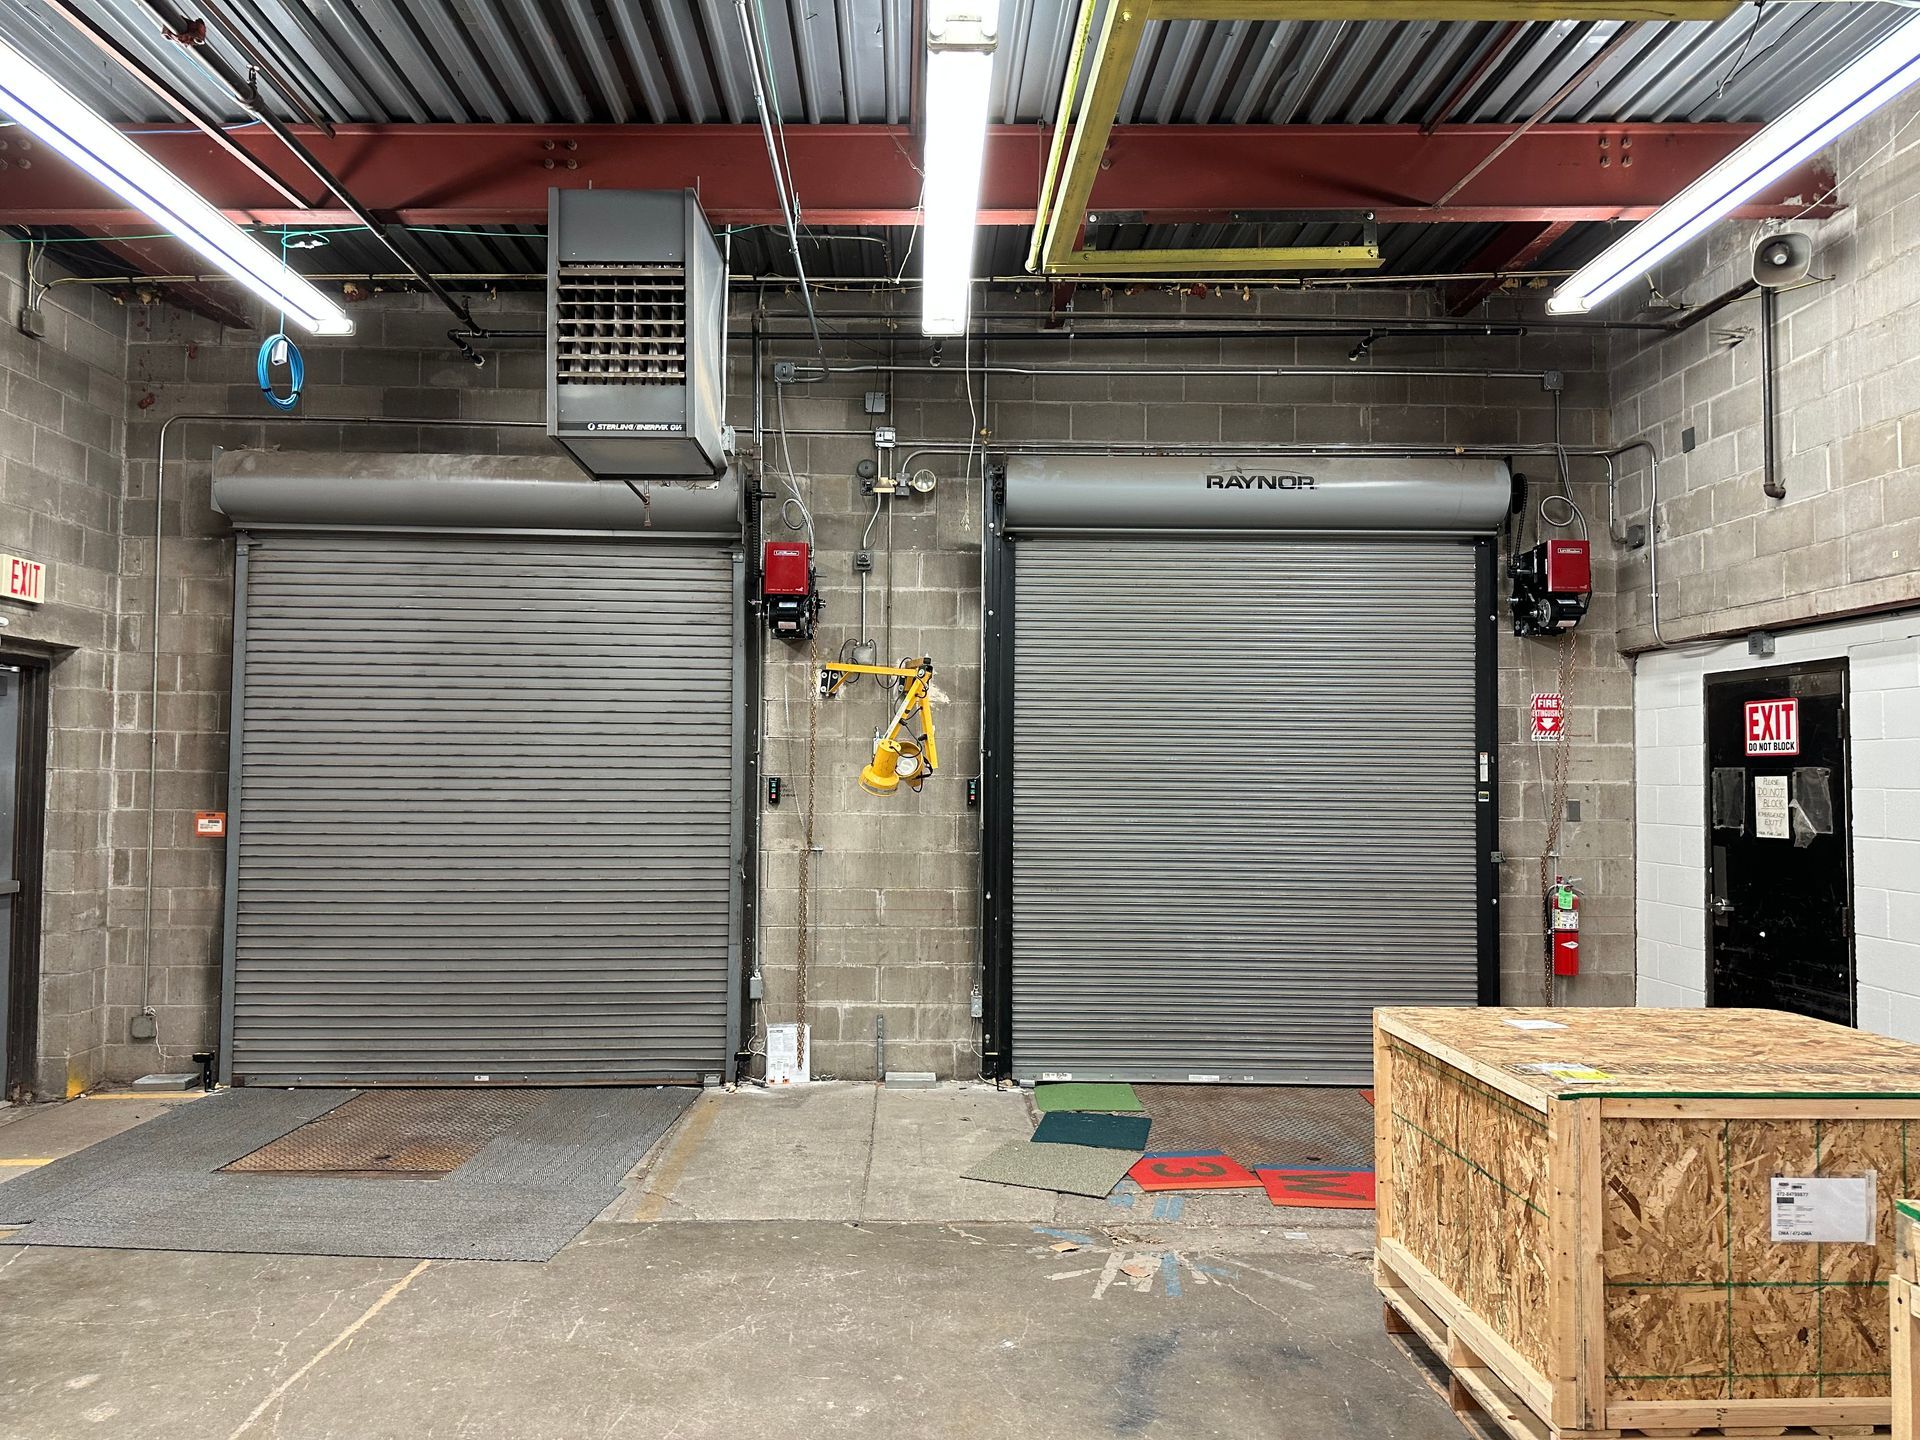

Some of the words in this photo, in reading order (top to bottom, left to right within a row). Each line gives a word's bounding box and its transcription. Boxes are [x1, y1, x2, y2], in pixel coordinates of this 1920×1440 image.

[1206, 475, 1315, 490] RAYNOR
[11, 559, 40, 598] EXIT
[1537, 699, 1558, 708] FIRE
[1749, 704, 1794, 740] EXIT
[1749, 743, 1758, 751] DO
[1759, 742, 1772, 751] NOT
[1773, 741, 1795, 751] BLOCK
[1758, 787, 1767, 795] DO
[1770, 788, 1785, 797] NOT
[1763, 799, 1783, 808] BLOCK
